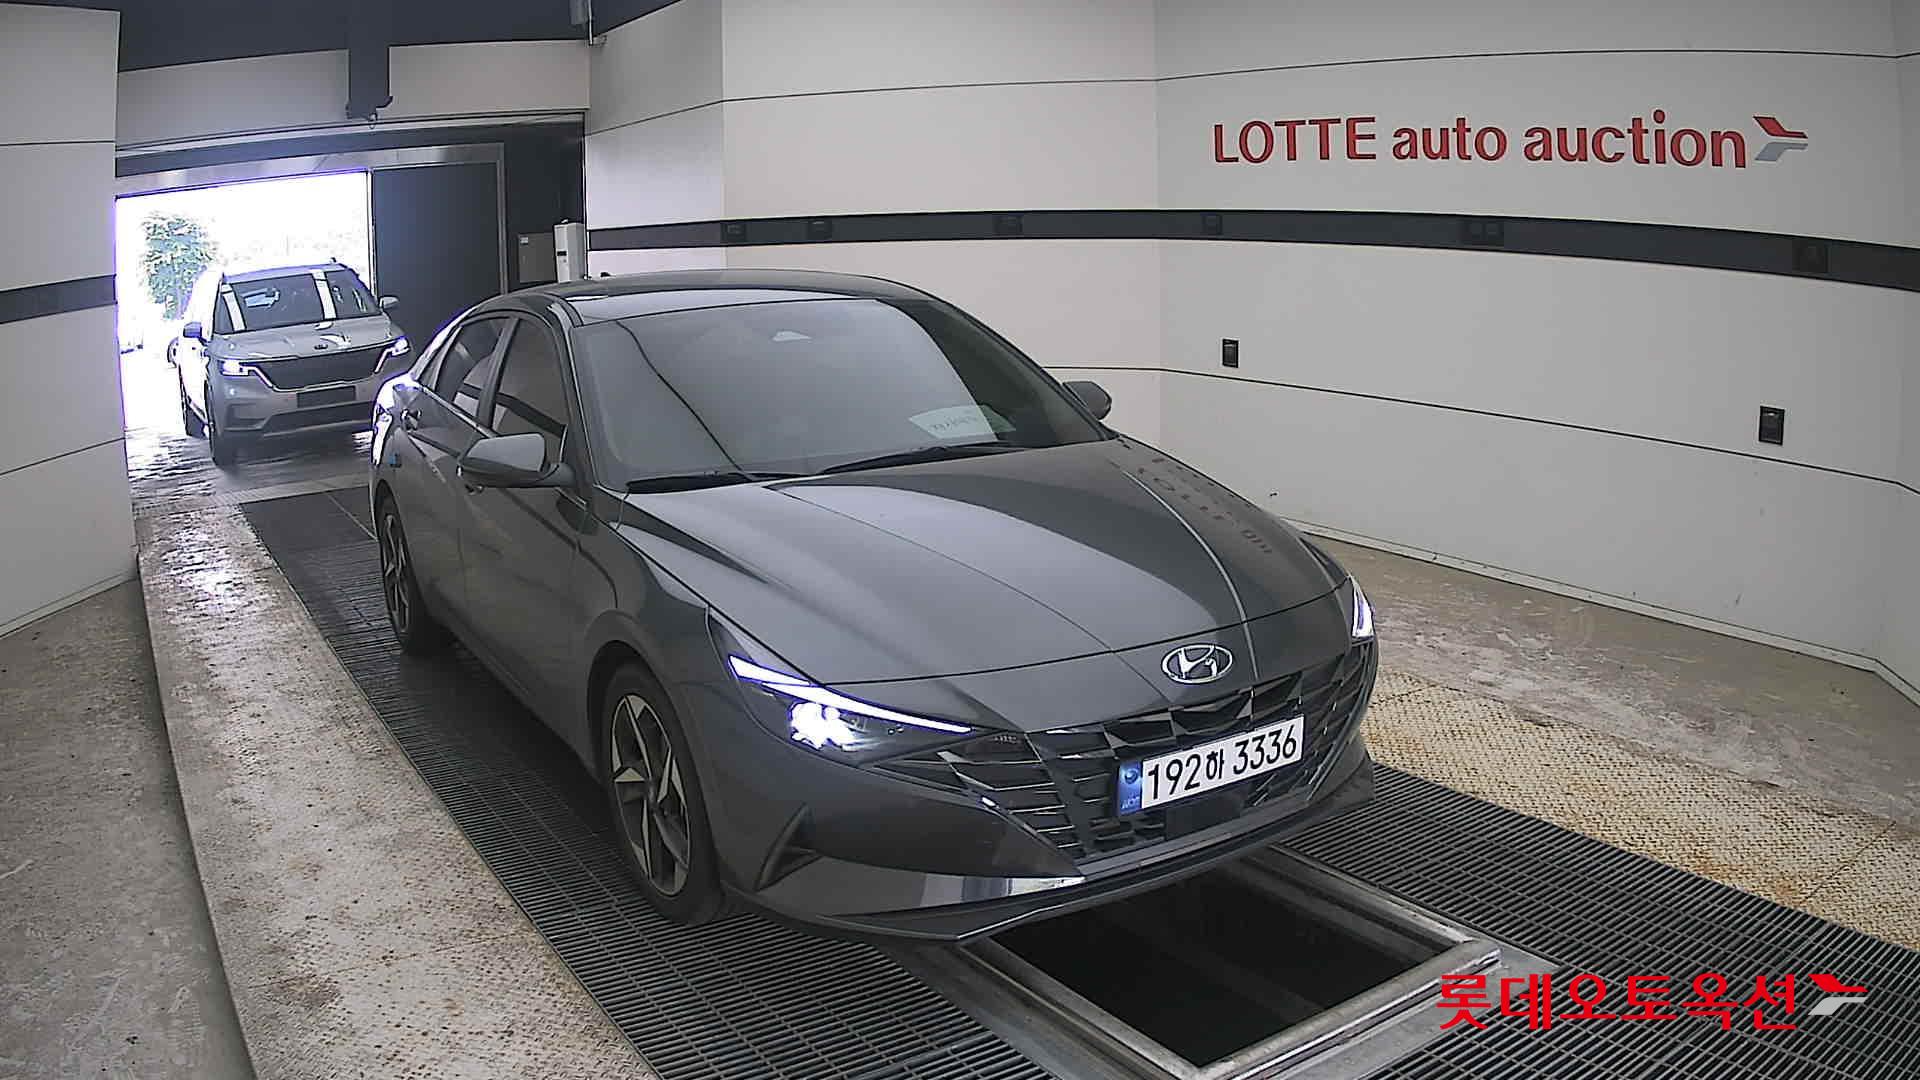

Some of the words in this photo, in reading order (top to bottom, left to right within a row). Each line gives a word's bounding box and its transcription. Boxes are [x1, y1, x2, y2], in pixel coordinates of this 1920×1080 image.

[1213, 117, 1377, 163] LOTTE
[1392, 117, 1508, 161] auto
[1523, 110, 1747, 168] auction
[1148, 748, 1225, 800] 192하
[1233, 724, 1297, 776] 3336
